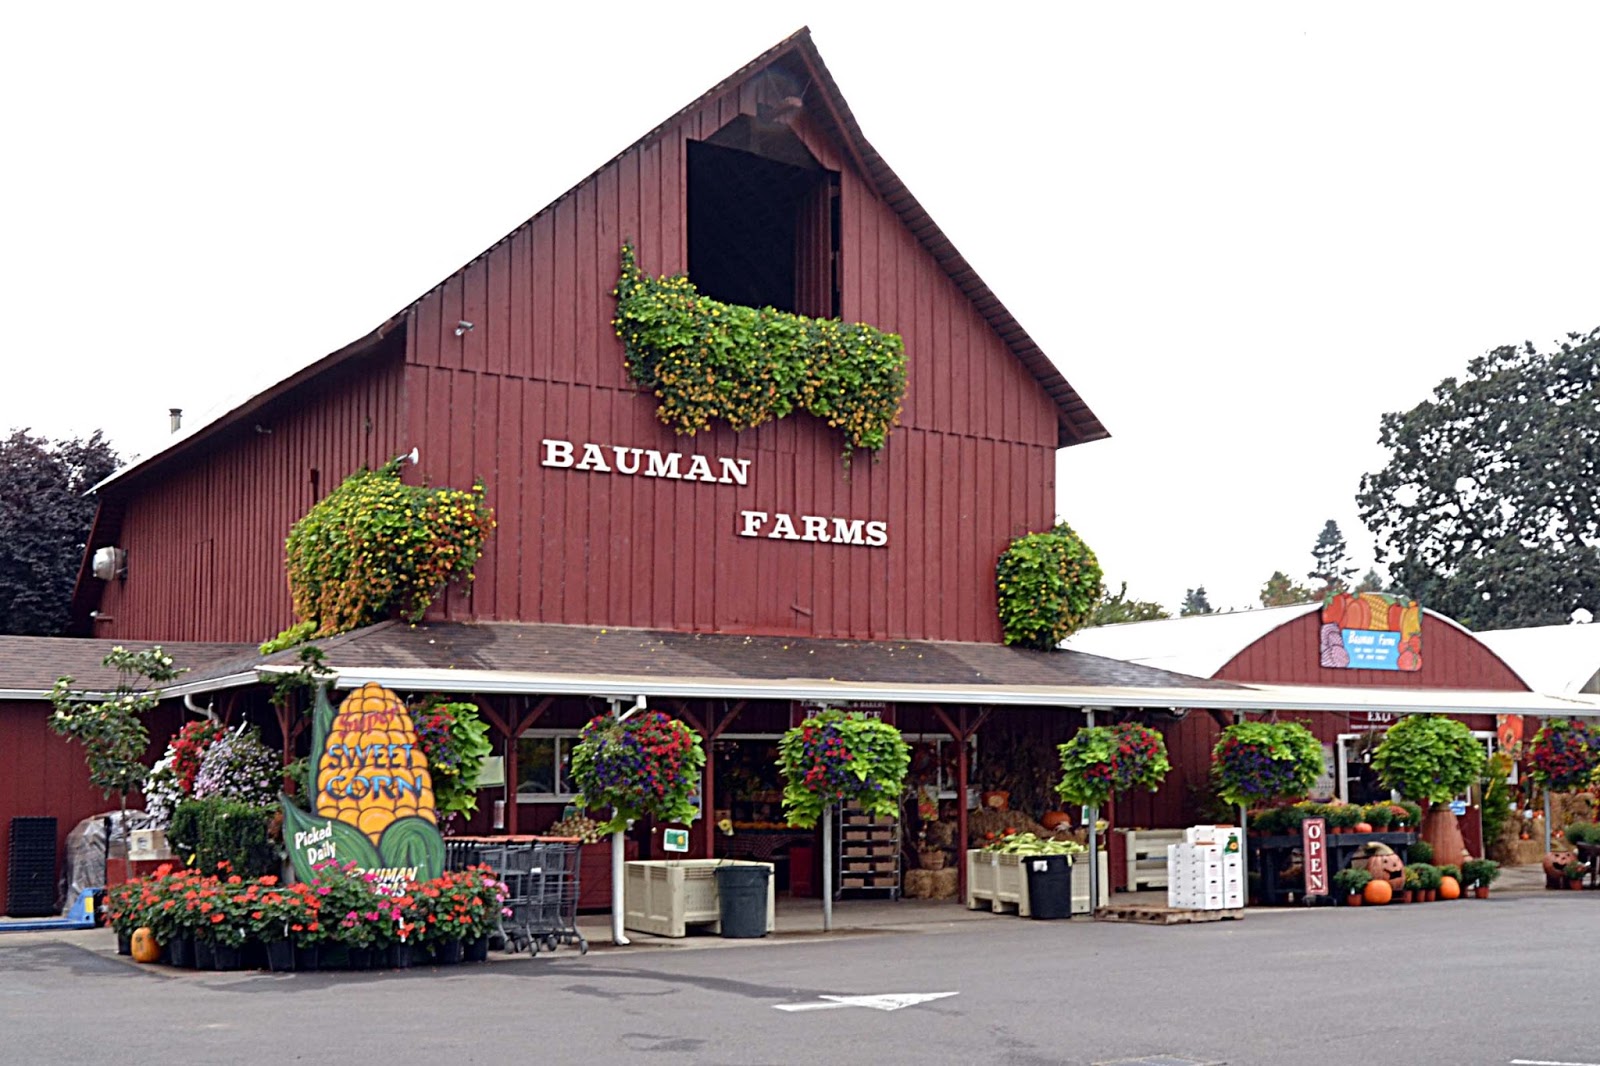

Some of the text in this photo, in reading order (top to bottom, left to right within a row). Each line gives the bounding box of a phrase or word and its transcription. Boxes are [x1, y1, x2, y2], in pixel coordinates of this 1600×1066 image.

[541, 438, 751, 486] BAUMAN
[740, 510, 889, 547] FARMS
[328, 743, 413, 769] SWEET
[326, 774, 423, 800] CORN
[294, 820, 333, 850] Picked
[307, 840, 336, 866] Daily
[1308, 825, 1323, 889] OPEN
